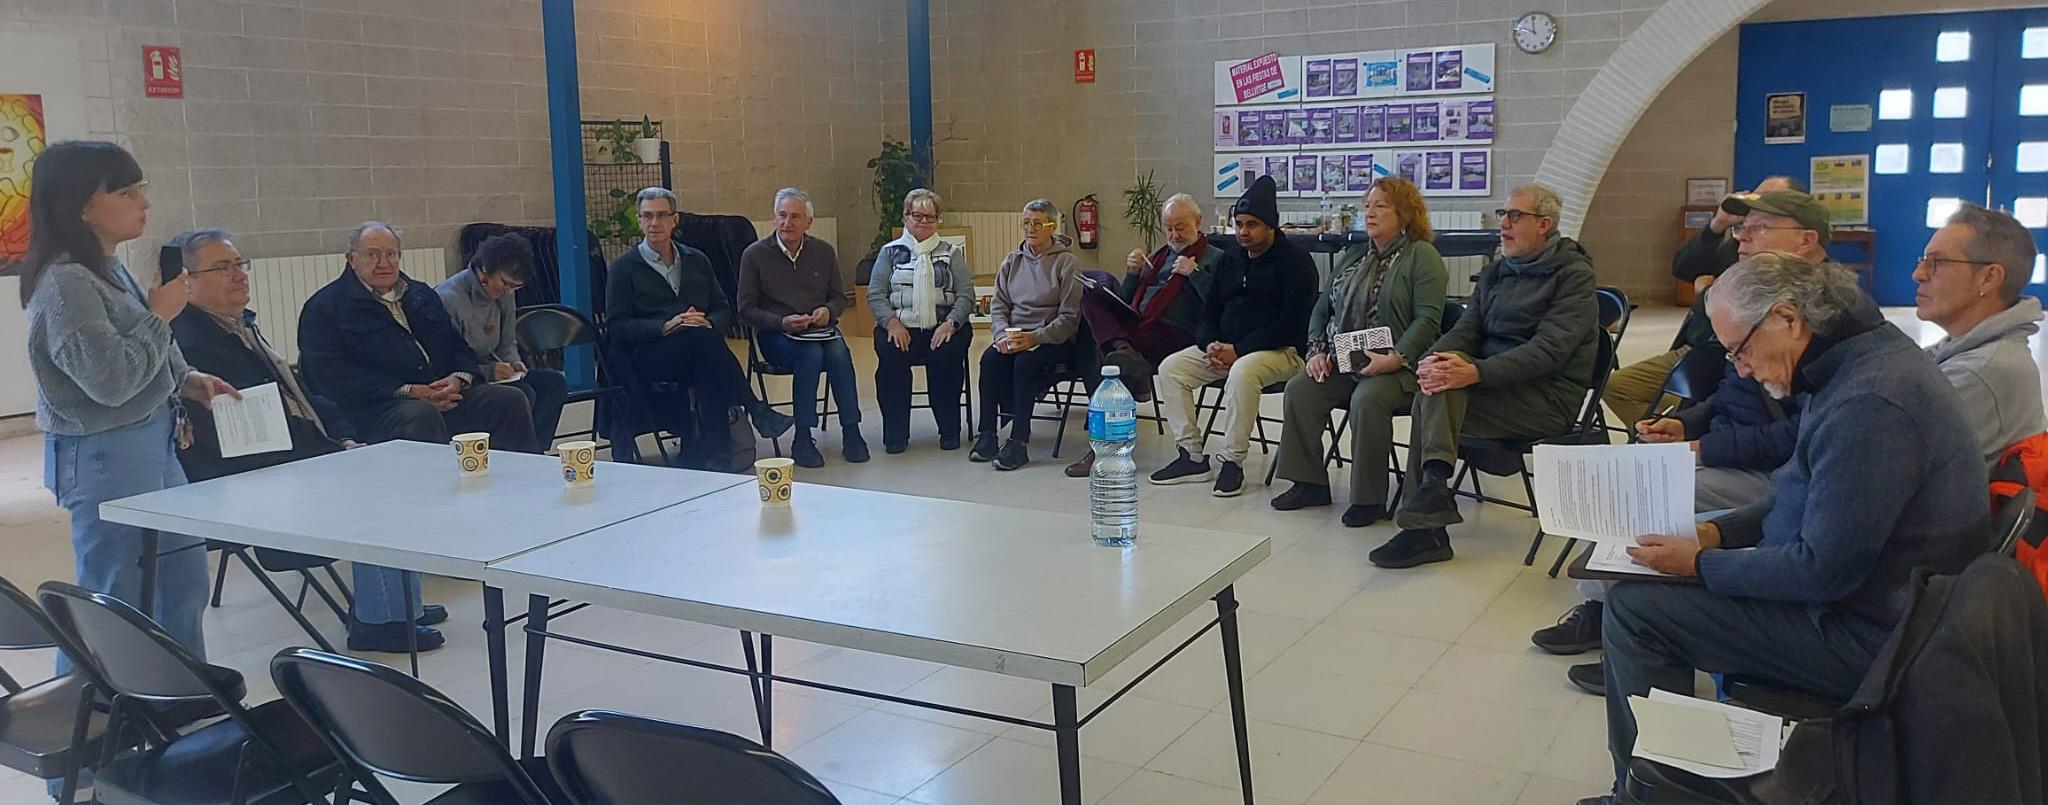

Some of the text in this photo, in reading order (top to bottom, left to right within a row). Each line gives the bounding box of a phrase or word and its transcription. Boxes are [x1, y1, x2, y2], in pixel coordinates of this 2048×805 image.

[1231, 53, 1276, 77] MATERIAL EXPUESTO
[1236, 66, 1278, 88] EN LAS FIESTAS DE
